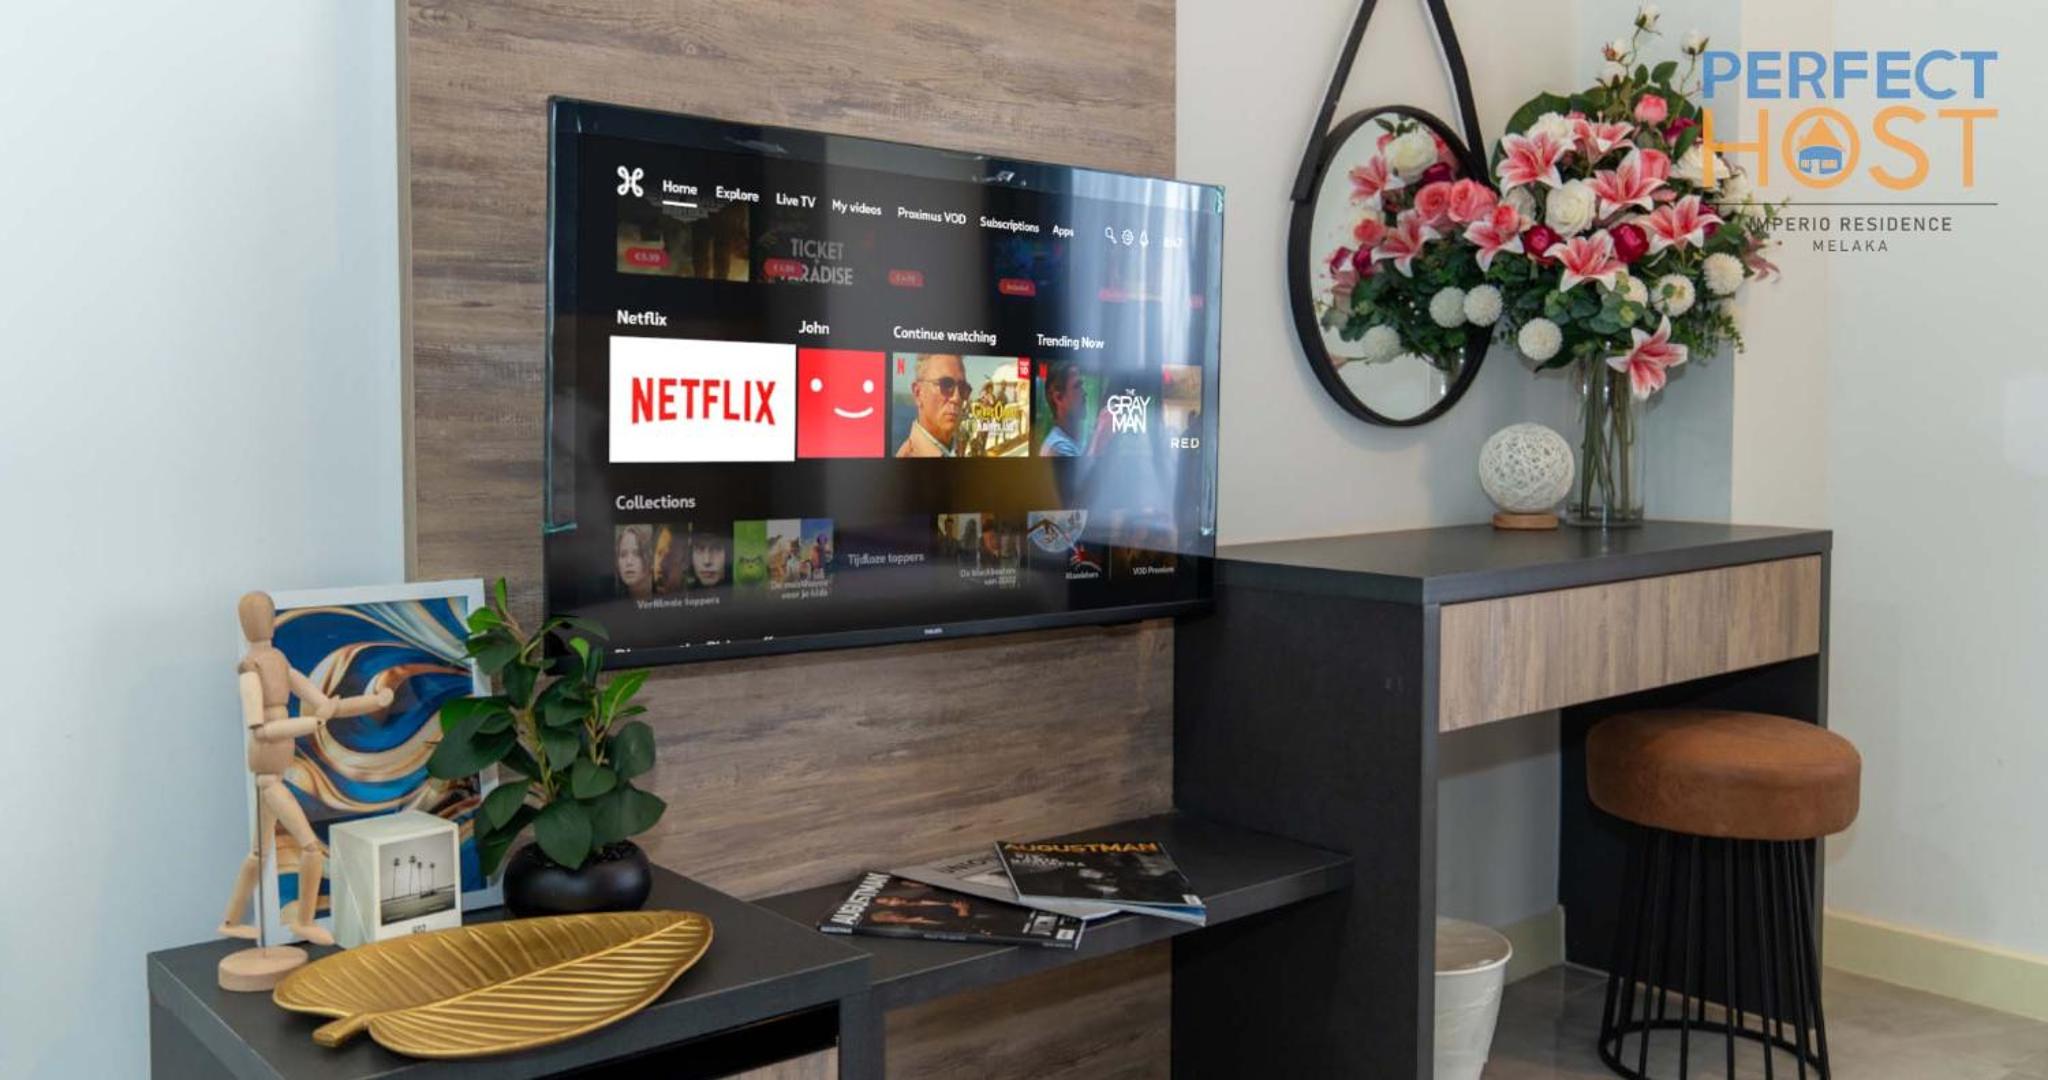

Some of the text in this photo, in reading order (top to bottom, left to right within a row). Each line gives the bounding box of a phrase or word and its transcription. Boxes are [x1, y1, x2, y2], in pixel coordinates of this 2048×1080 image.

[662, 179, 698, 196] Home
[715, 186, 759, 203] Explore
[775, 192, 816, 208] Live TV
[832, 199, 882, 215] My videos
[897, 206, 966, 225] Proximus VOD
[979, 216, 1040, 234] Subscriptions
[1052, 225, 1074, 238] Apps
[790, 238, 844, 260] TICKET
[779, 263, 854, 286] RADISE
[616, 310, 668, 327] Netflix
[798, 321, 830, 335] John
[893, 325, 998, 347] Continue watching
[1037, 333, 1105, 351] Trending Now
[631, 377, 776, 425] NETFLIX
[1107, 395, 1151, 415] GRAY
[1112, 412, 1147, 433] MAN
[1170, 437, 1200, 449] RED
[615, 495, 696, 511] Collections
[1004, 842, 1158, 854] AUGUSTMAN
